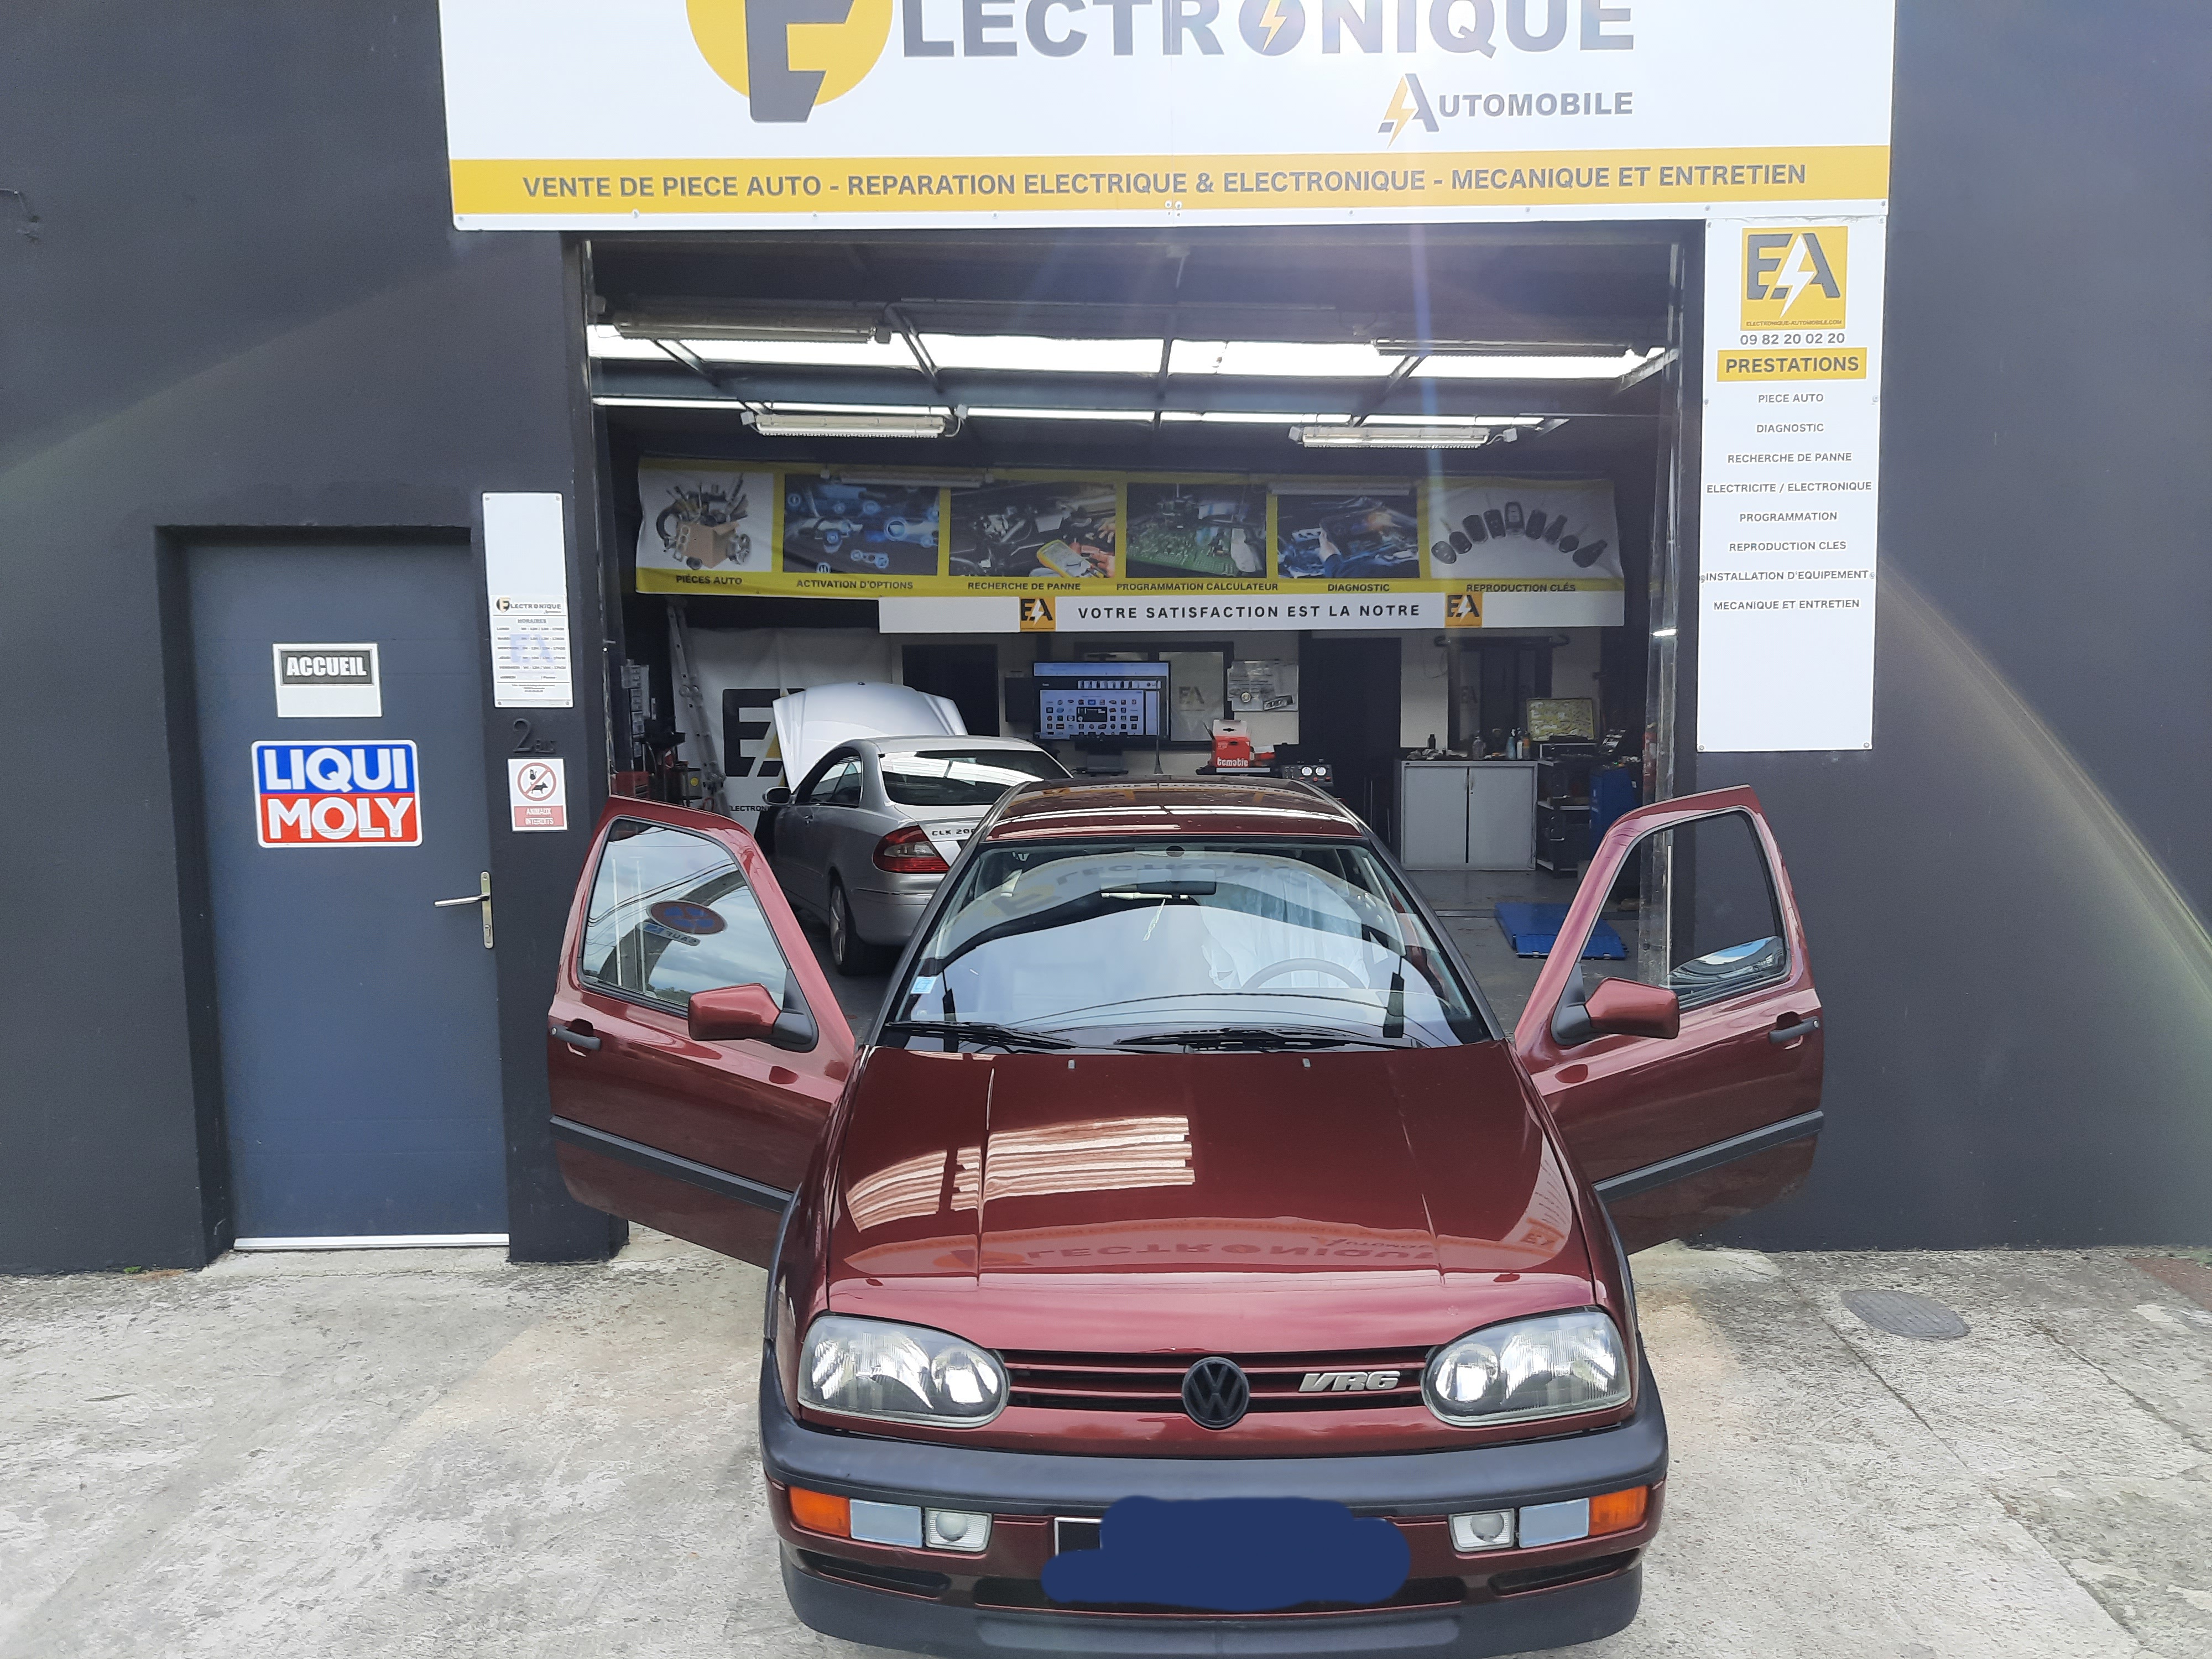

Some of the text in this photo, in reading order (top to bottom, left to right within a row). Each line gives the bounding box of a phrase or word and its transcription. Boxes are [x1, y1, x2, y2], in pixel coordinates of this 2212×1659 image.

[523, 176, 610, 197] VENTE
[620, 176, 655, 197] DE
[663, 176, 738, 197] PIECE
[747, 175, 822, 197] AUTO
[848, 174, 1016, 196] REPARATION
[1025, 172, 1187, 195] ELECTRIQUE
[1195, 172, 1214, 194] &
[1223, 170, 1426, 194] ELECTRONIQUE
[1451, 166, 1610, 190] MECANIQUE
[1619, 166, 1652, 188] ET
[1658, 164, 1806, 187] ENTRETIEN
[1740, 333, 1845, 345] 09 82 20 02 20
[1725, 357, 1859, 373] PRESTATIONS
[1758, 394, 1824, 403] PIECE AUTO
[1756, 424, 1824, 433] DIAGNOSTIC
[1728, 452, 1852, 463] RECHERCHE DE PANNE
[1707, 482, 1872, 493] ELECTRICITE / ELECTRONIQUE
[1739, 512, 1838, 522] PROGRAMMATION
[1729, 541, 1846, 552] REPRODUCTION CLES
[714, 576, 743, 585] AUTO
[1706, 570, 1869, 581] INSTALLATION D'EQUIPEMENT
[796, 579, 914, 589] ACTIVATION D'OPTIONS
[968, 582, 1081, 591] RECHERCHE DE PANNE
[1117, 582, 1279, 591] PROGRAMMATION CALCULATEUR
[1327, 583, 1390, 592] DIAGNOSTIC
[1466, 581, 1576, 592] REPRODUCTION CLÉS
[1714, 599, 1860, 611] MECANIQUE ET ENTRETIEN
[1078, 604, 1420, 619] VOTRE SATISFACTION EST LA NOTRE
[286, 655, 368, 677] ACCUEIL
[513, 718, 531, 753] 2
[263, 747, 408, 793] LIQUI
[267, 796, 414, 839] MOLY
[1298, 1371, 1401, 1392] VR6
